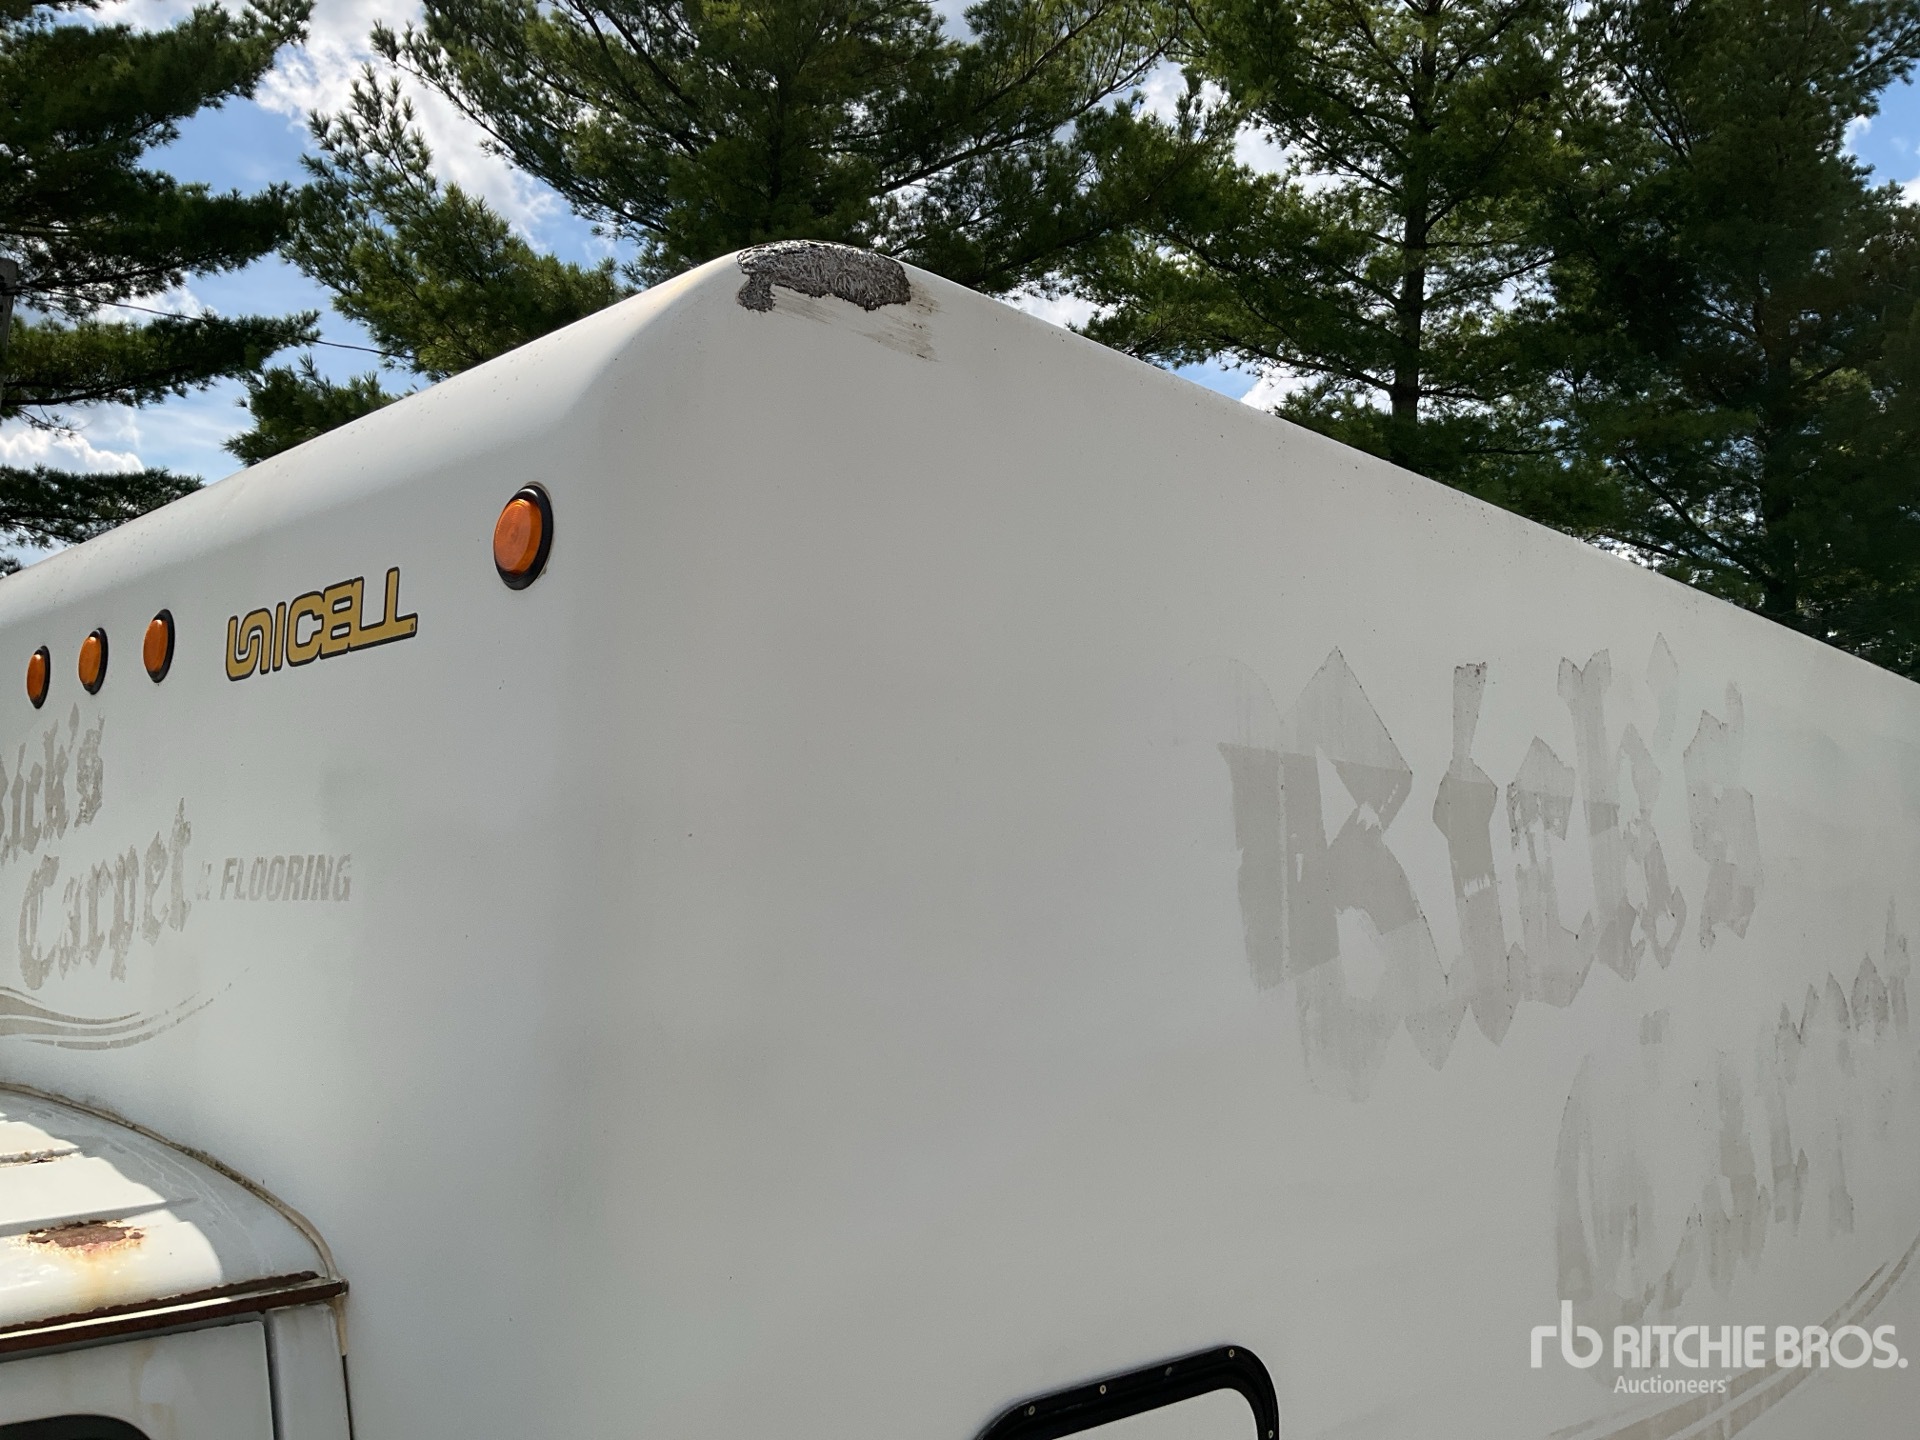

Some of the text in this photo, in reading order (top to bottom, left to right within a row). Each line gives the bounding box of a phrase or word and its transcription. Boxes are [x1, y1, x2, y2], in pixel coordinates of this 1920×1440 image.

[225, 566, 419, 682] UNICELL
[0, 702, 105, 866] ick's
[19, 797, 192, 990] Carpet
[220, 854, 352, 902] FLOORING
